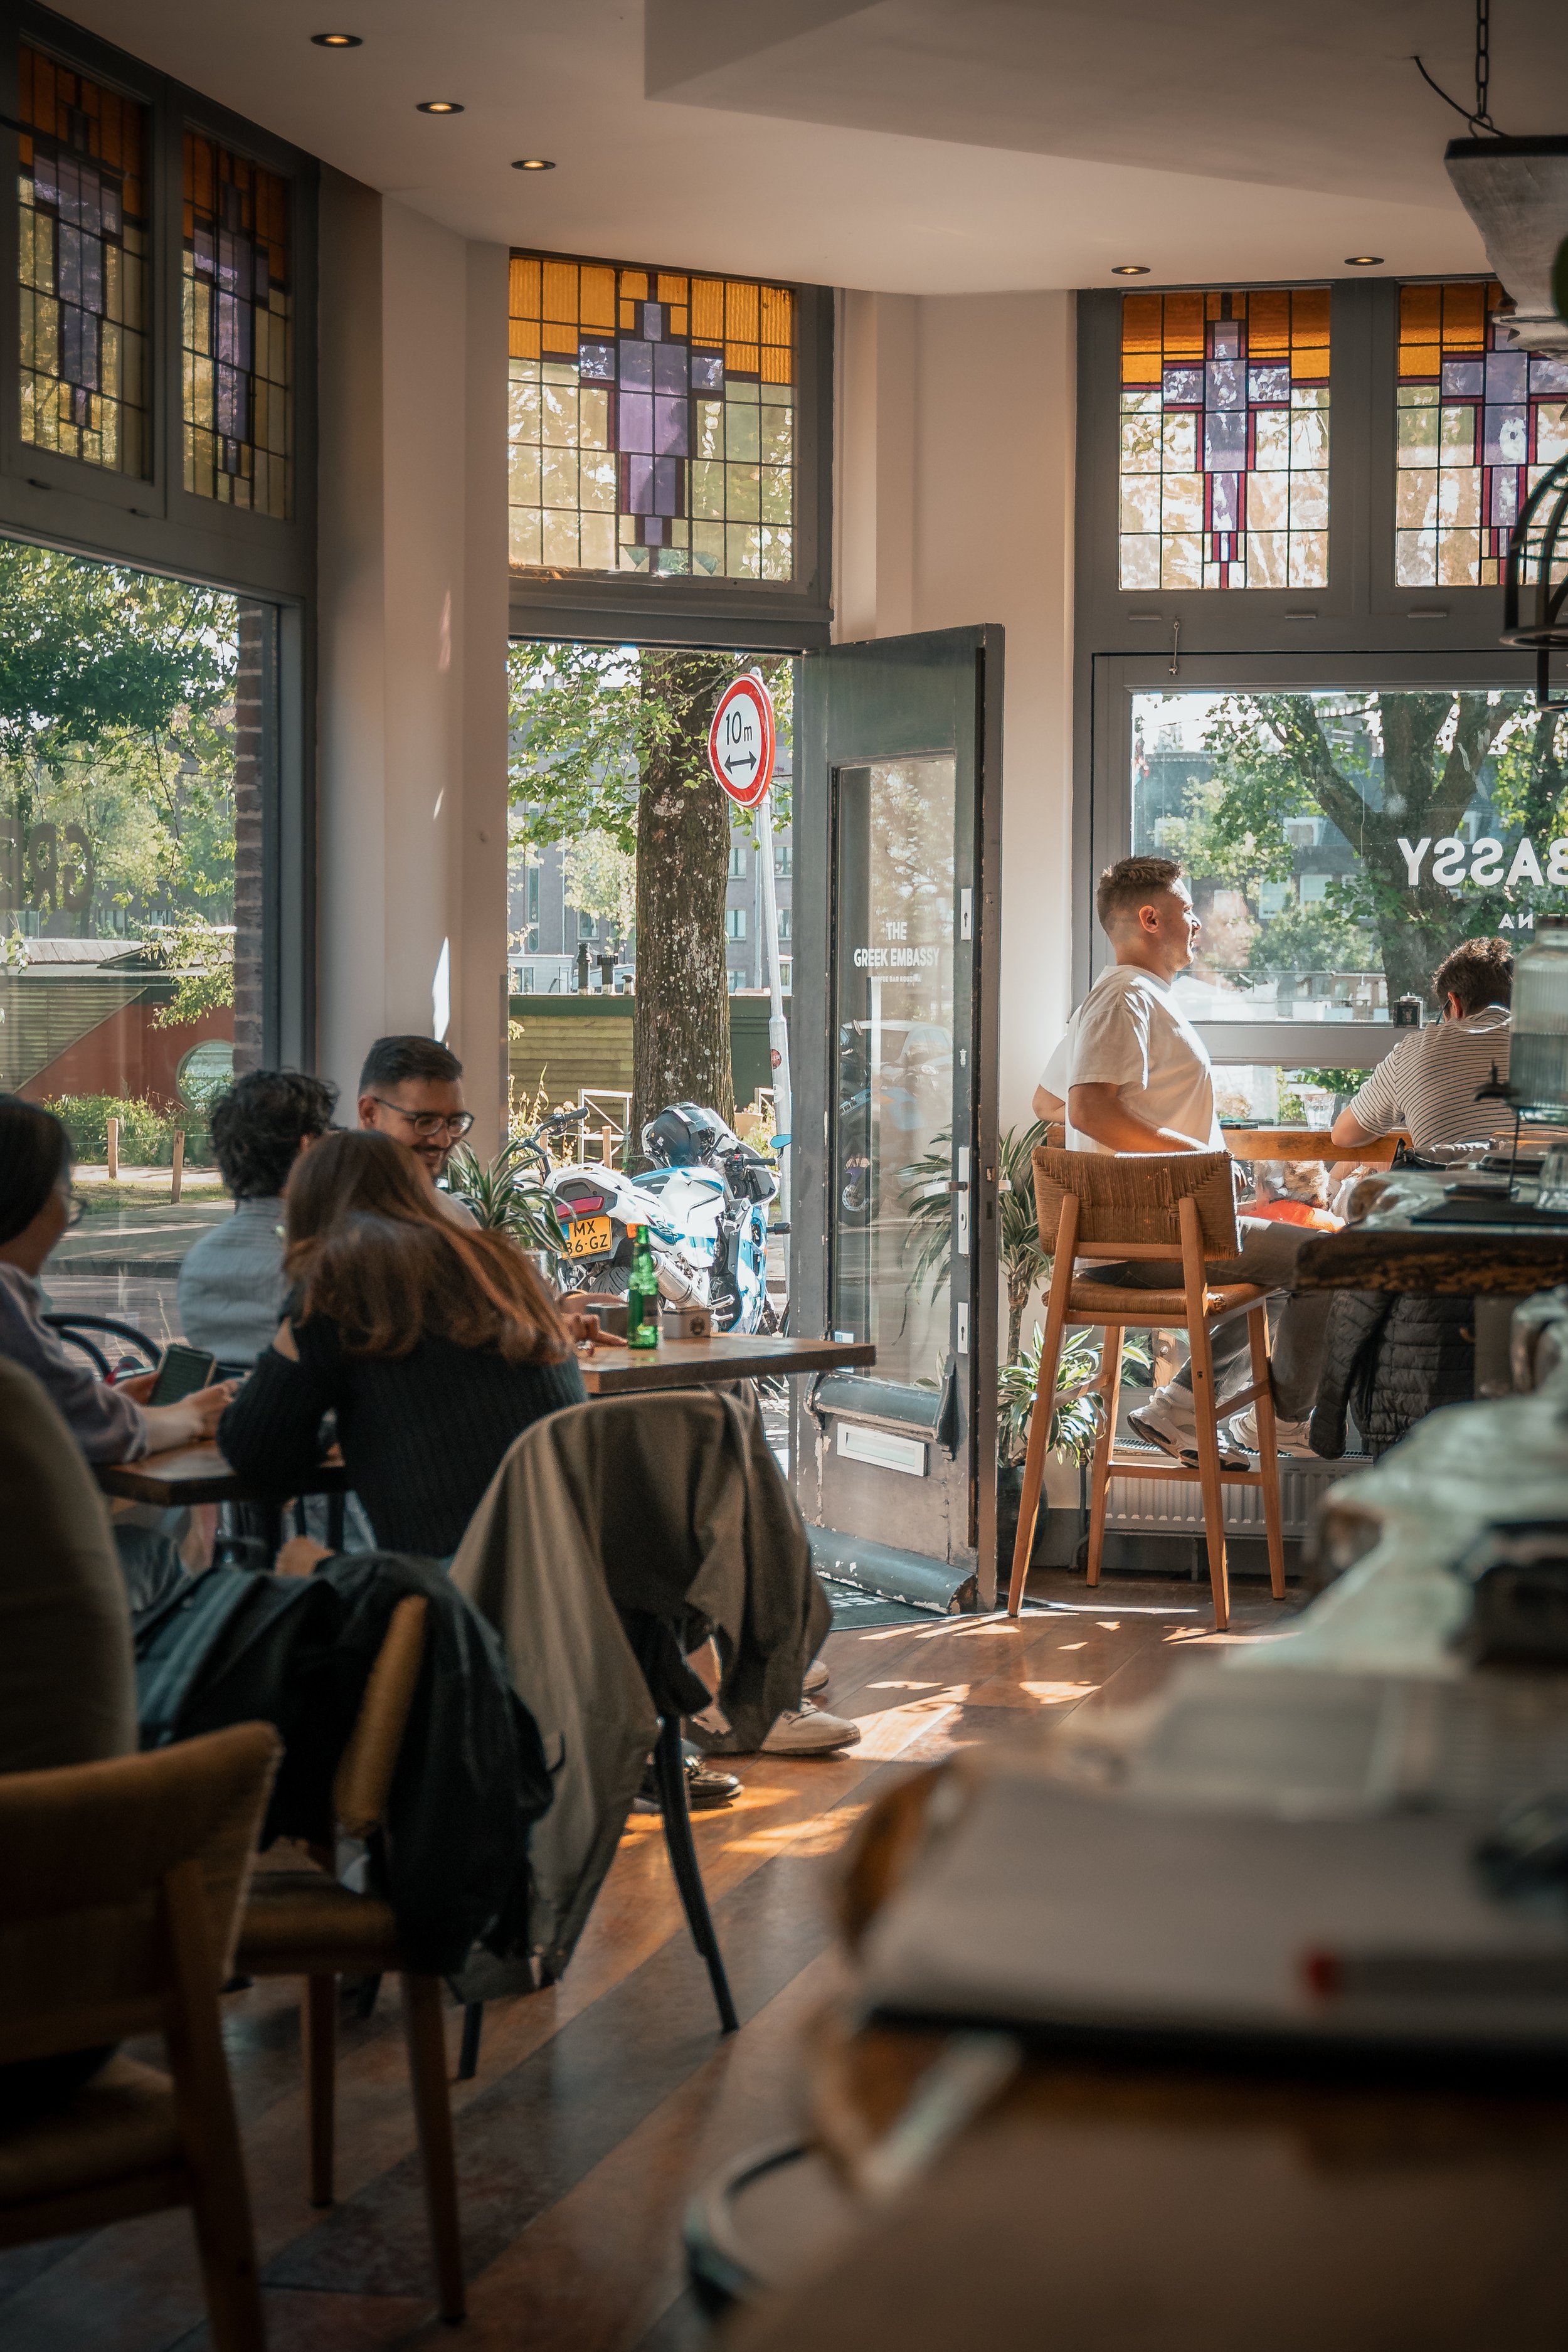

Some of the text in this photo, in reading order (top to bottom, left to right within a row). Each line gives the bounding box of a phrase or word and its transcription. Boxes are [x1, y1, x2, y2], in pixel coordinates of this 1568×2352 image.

[886, 921, 908, 940] THE
[854, 948, 940, 967] GREEK EMBASSY
[574, 1220, 595, 1237] MX
